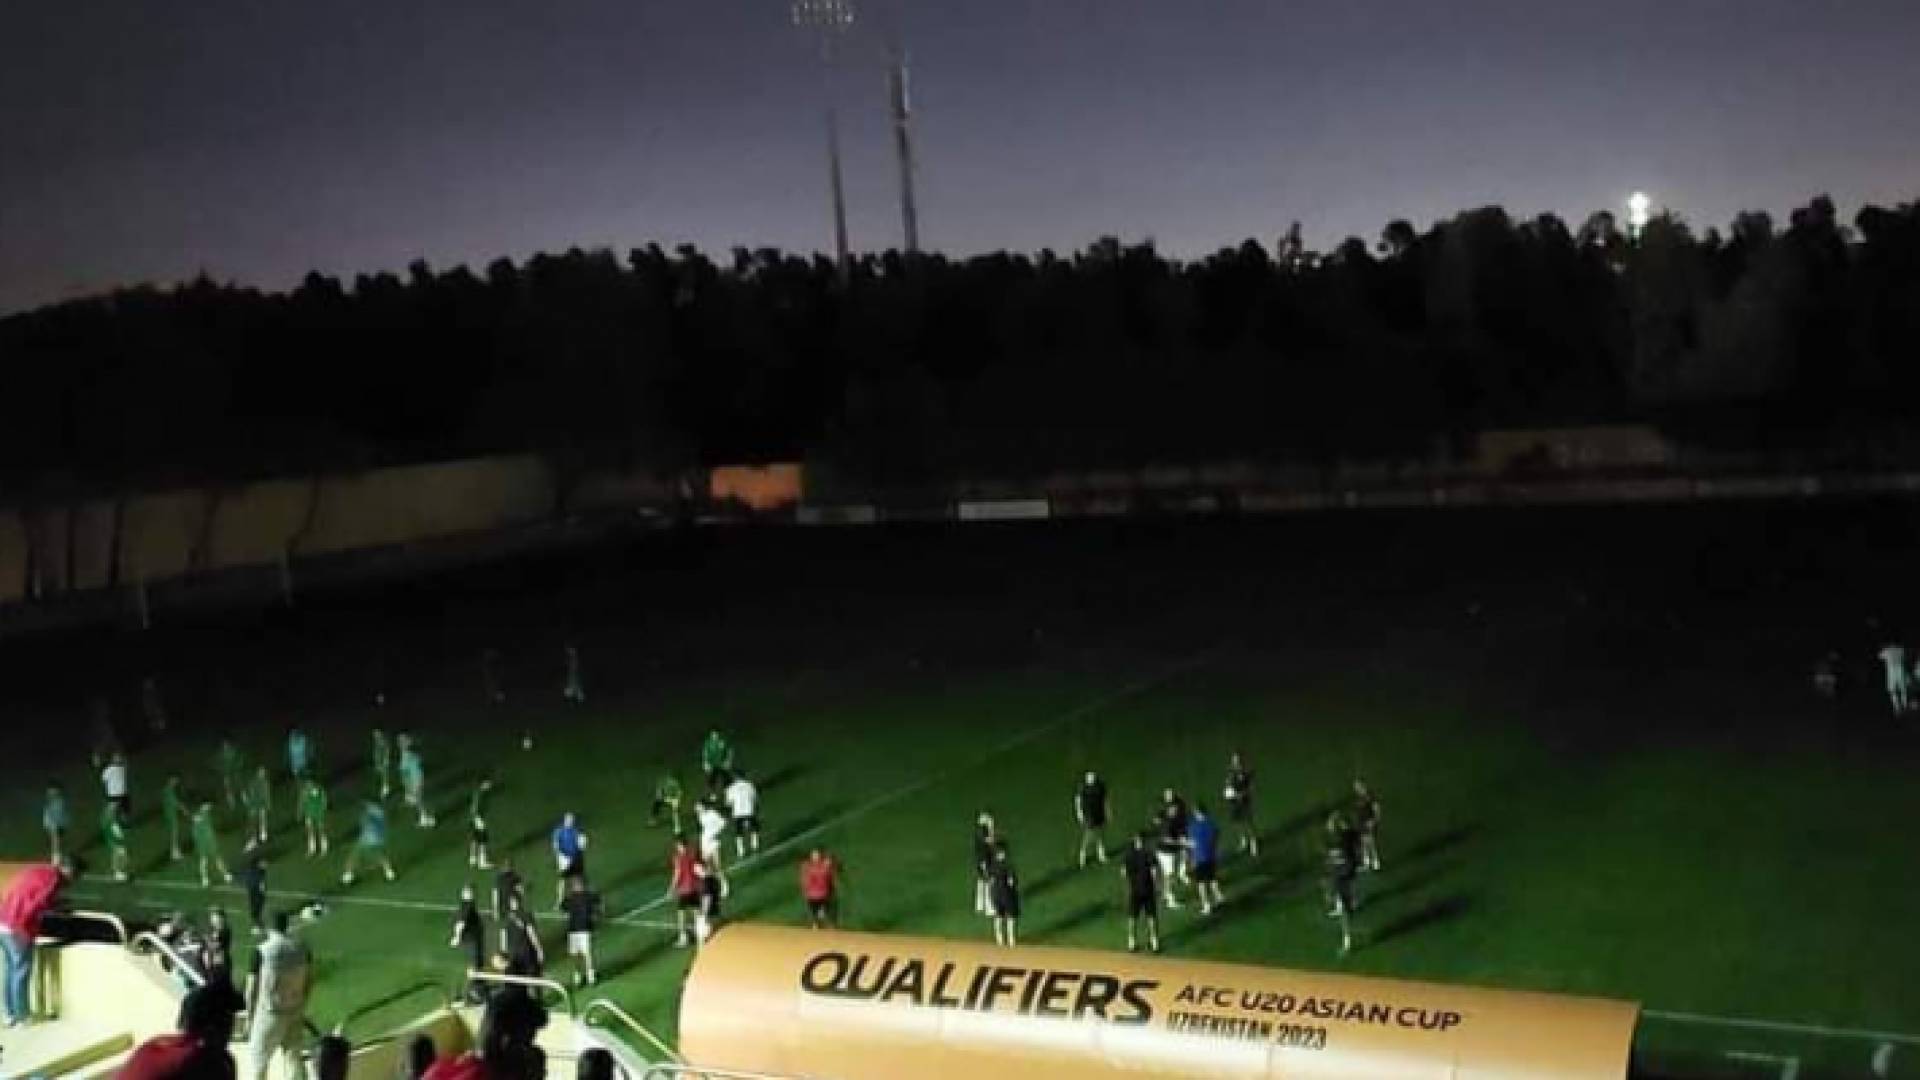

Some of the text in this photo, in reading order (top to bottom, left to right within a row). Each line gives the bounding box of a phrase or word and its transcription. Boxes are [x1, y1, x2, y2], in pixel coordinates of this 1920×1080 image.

[801, 951, 1160, 1027] QUALIFIERS
[1175, 984, 1463, 1032] AFC U20 ASIAN CUP
[1277, 1021, 1327, 1050] 2023
